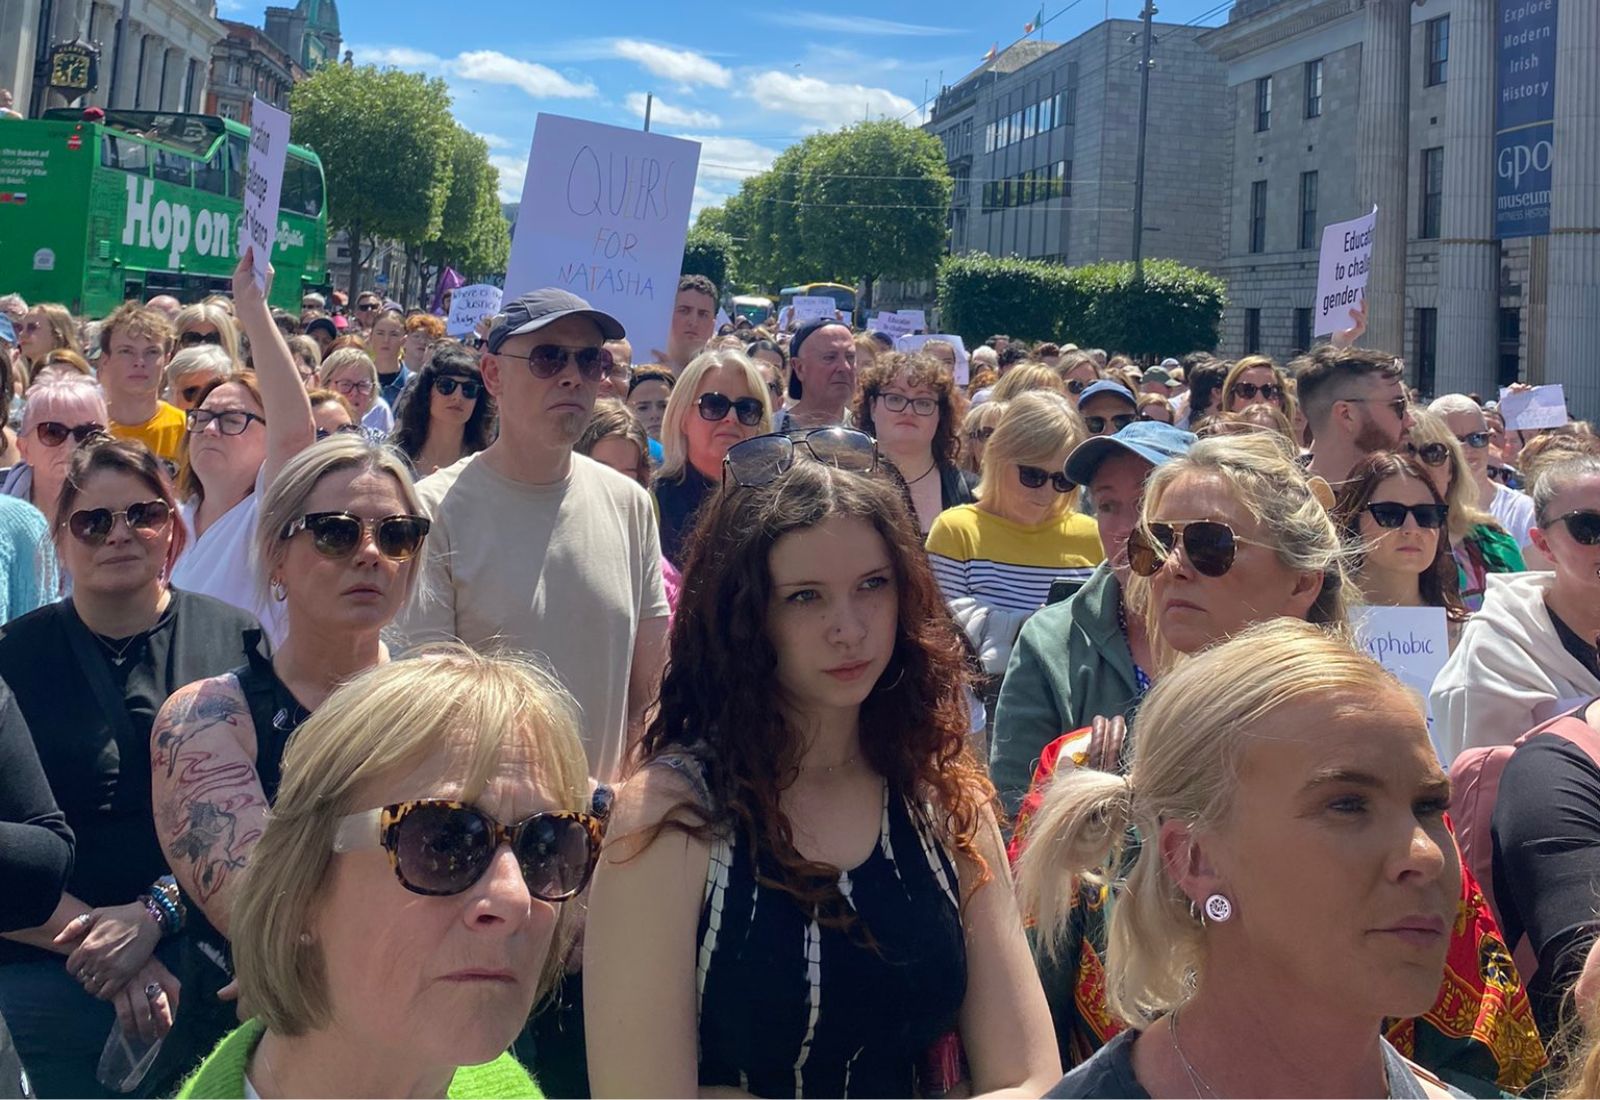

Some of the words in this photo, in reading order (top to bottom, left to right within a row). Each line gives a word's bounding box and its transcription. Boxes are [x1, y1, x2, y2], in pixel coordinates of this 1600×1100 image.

[1504, 0, 1552, 23] Explore
[1504, 26, 1550, 50] Modern
[1510, 52, 1539, 73] Irish
[1502, 81, 1549, 103] History
[567, 145, 676, 221] QUEERS
[1497, 190, 1551, 209] museum
[122, 174, 191, 268] Hop
[195, 208, 229, 257] on
[593, 227, 638, 262] FOR
[558, 263, 654, 300] NATASHA
[1335, 261, 1345, 281] to
[1323, 285, 1359, 316] gender
[1362, 632, 1434, 662] rphobic
